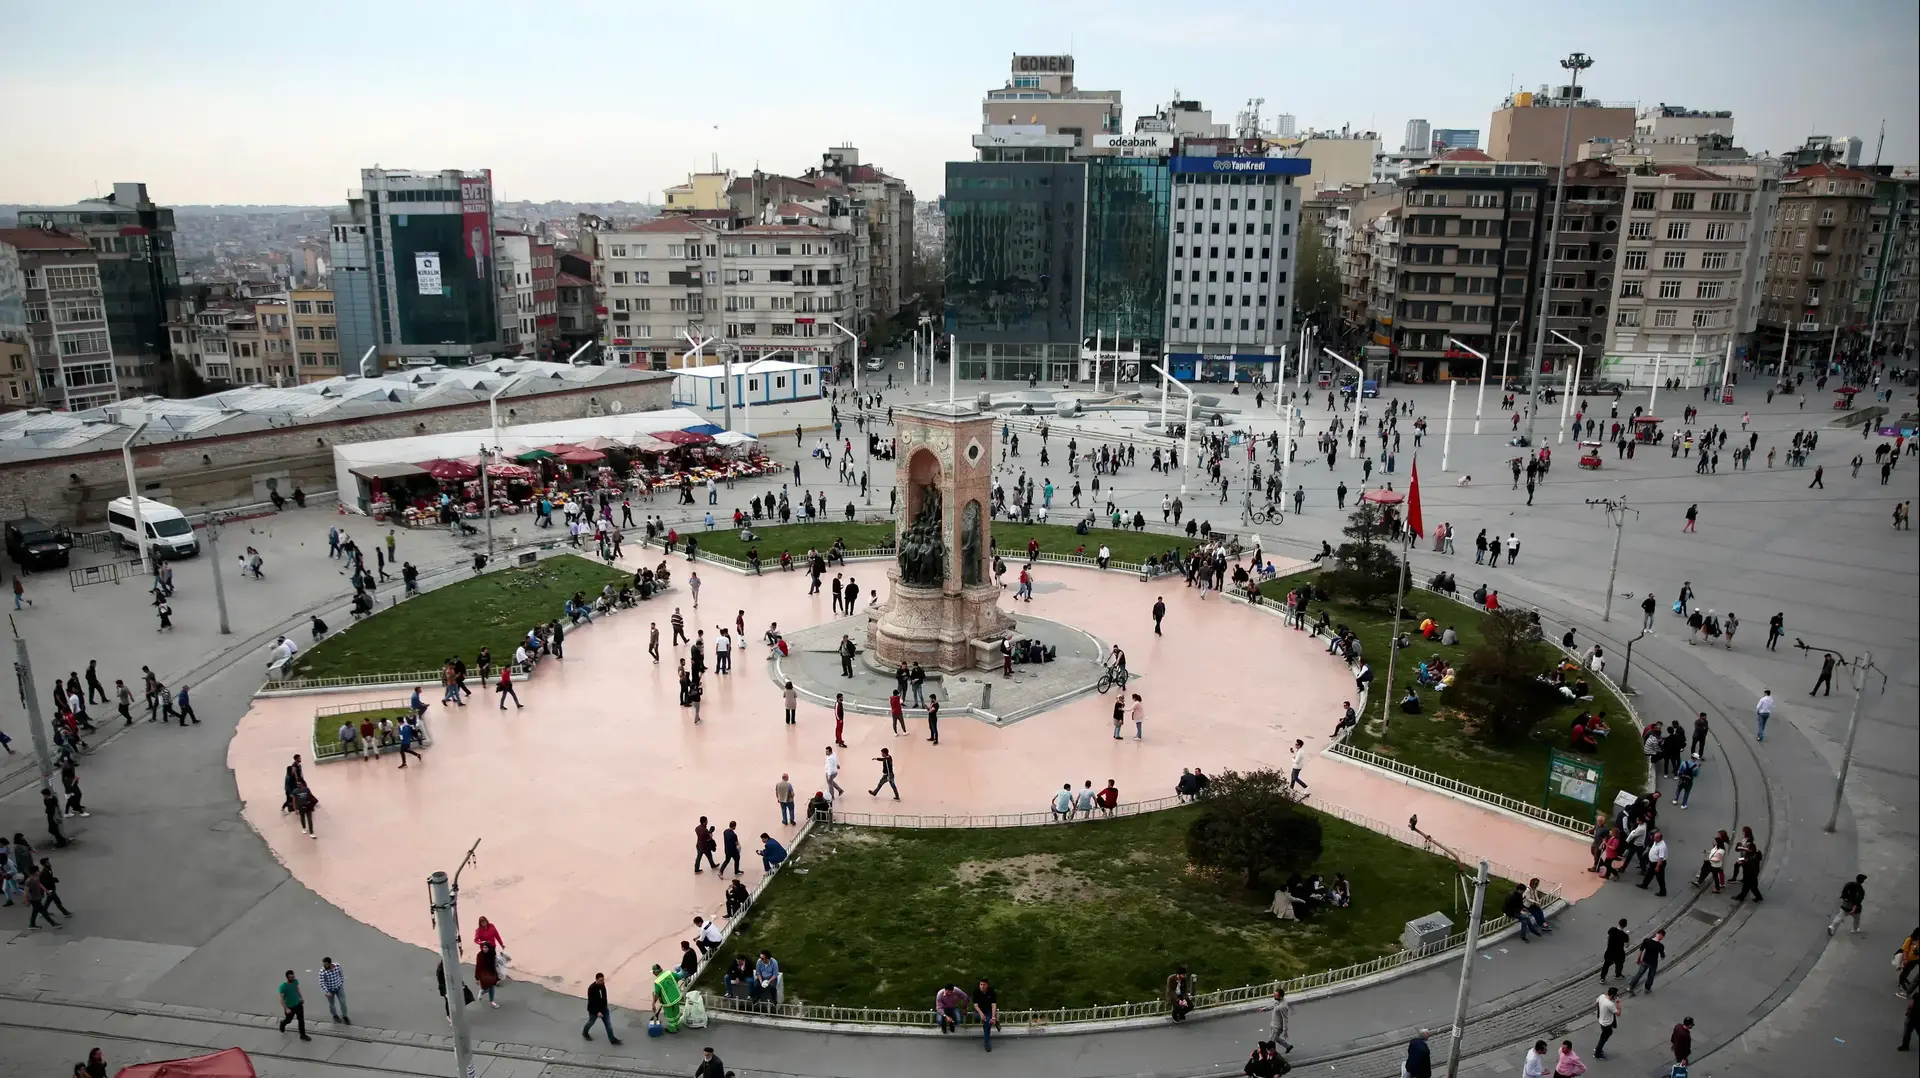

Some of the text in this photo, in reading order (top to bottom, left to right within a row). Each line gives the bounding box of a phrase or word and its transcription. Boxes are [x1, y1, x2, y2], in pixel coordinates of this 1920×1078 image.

[1109, 136, 1157, 147] odeabank
[461, 183, 486, 199] EVET
[144, 234, 152, 263] HOTEL
